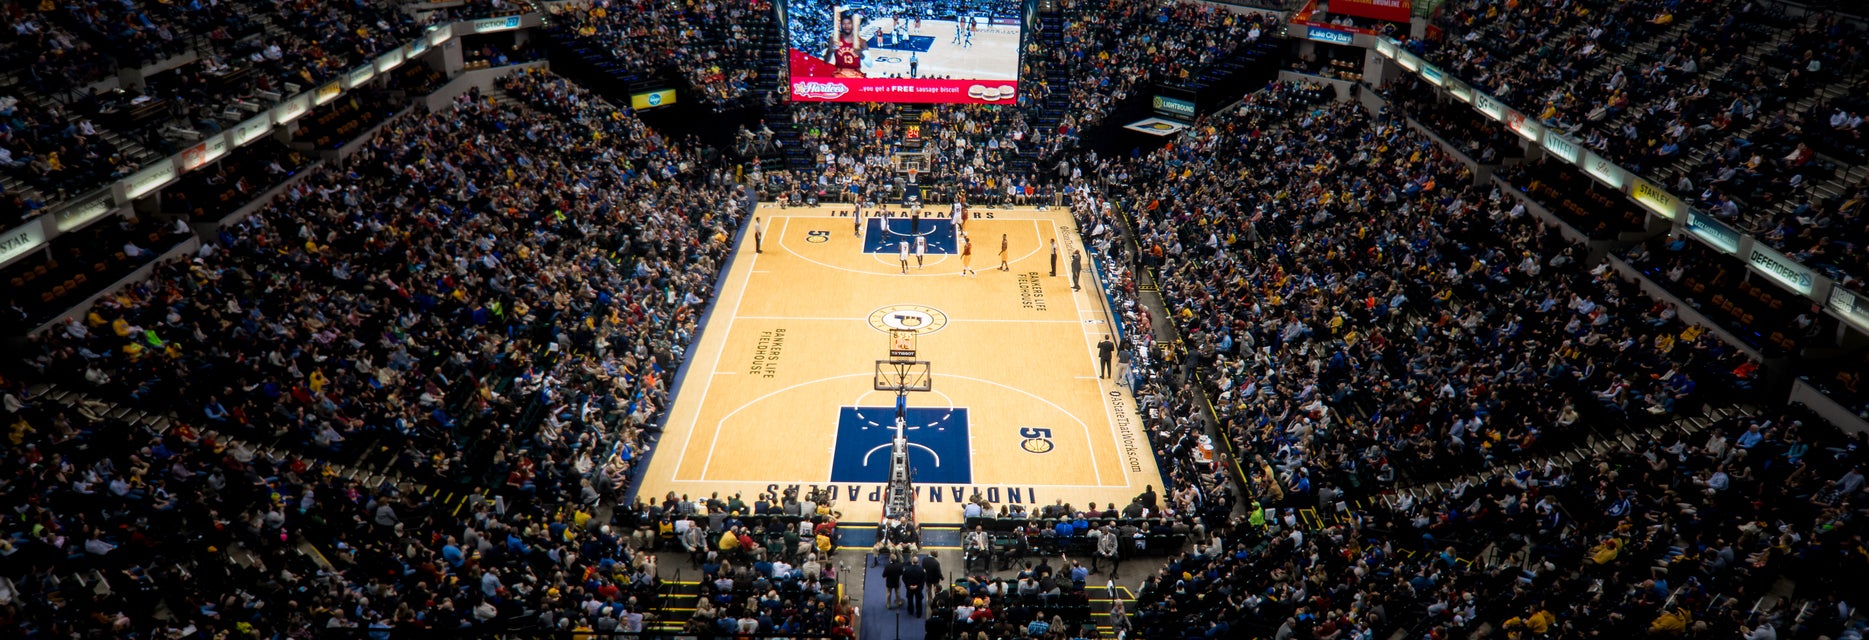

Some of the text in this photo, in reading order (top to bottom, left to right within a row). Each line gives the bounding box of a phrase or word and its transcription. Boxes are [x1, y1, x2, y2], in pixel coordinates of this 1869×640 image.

[476, 21, 505, 29] SECTION
[1312, 30, 1352, 42] Lake City Bank
[844, 55, 854, 64] 13
[1163, 101, 1194, 113] LIGHTBOUND
[908, 130, 919, 138] 24
[1640, 183, 1670, 206] STANLEY
[0, 232, 30, 254] STAR
[1750, 250, 1800, 284] DEFENDERS
[1017, 273, 1034, 309] FIELDHOUSE
[1029, 271, 1047, 312] BANKERS LIFE
[749, 331, 772, 375] FIELDHOUSE
[763, 328, 786, 379] BANKERS LIFE
[1020, 427, 1054, 453] 50
